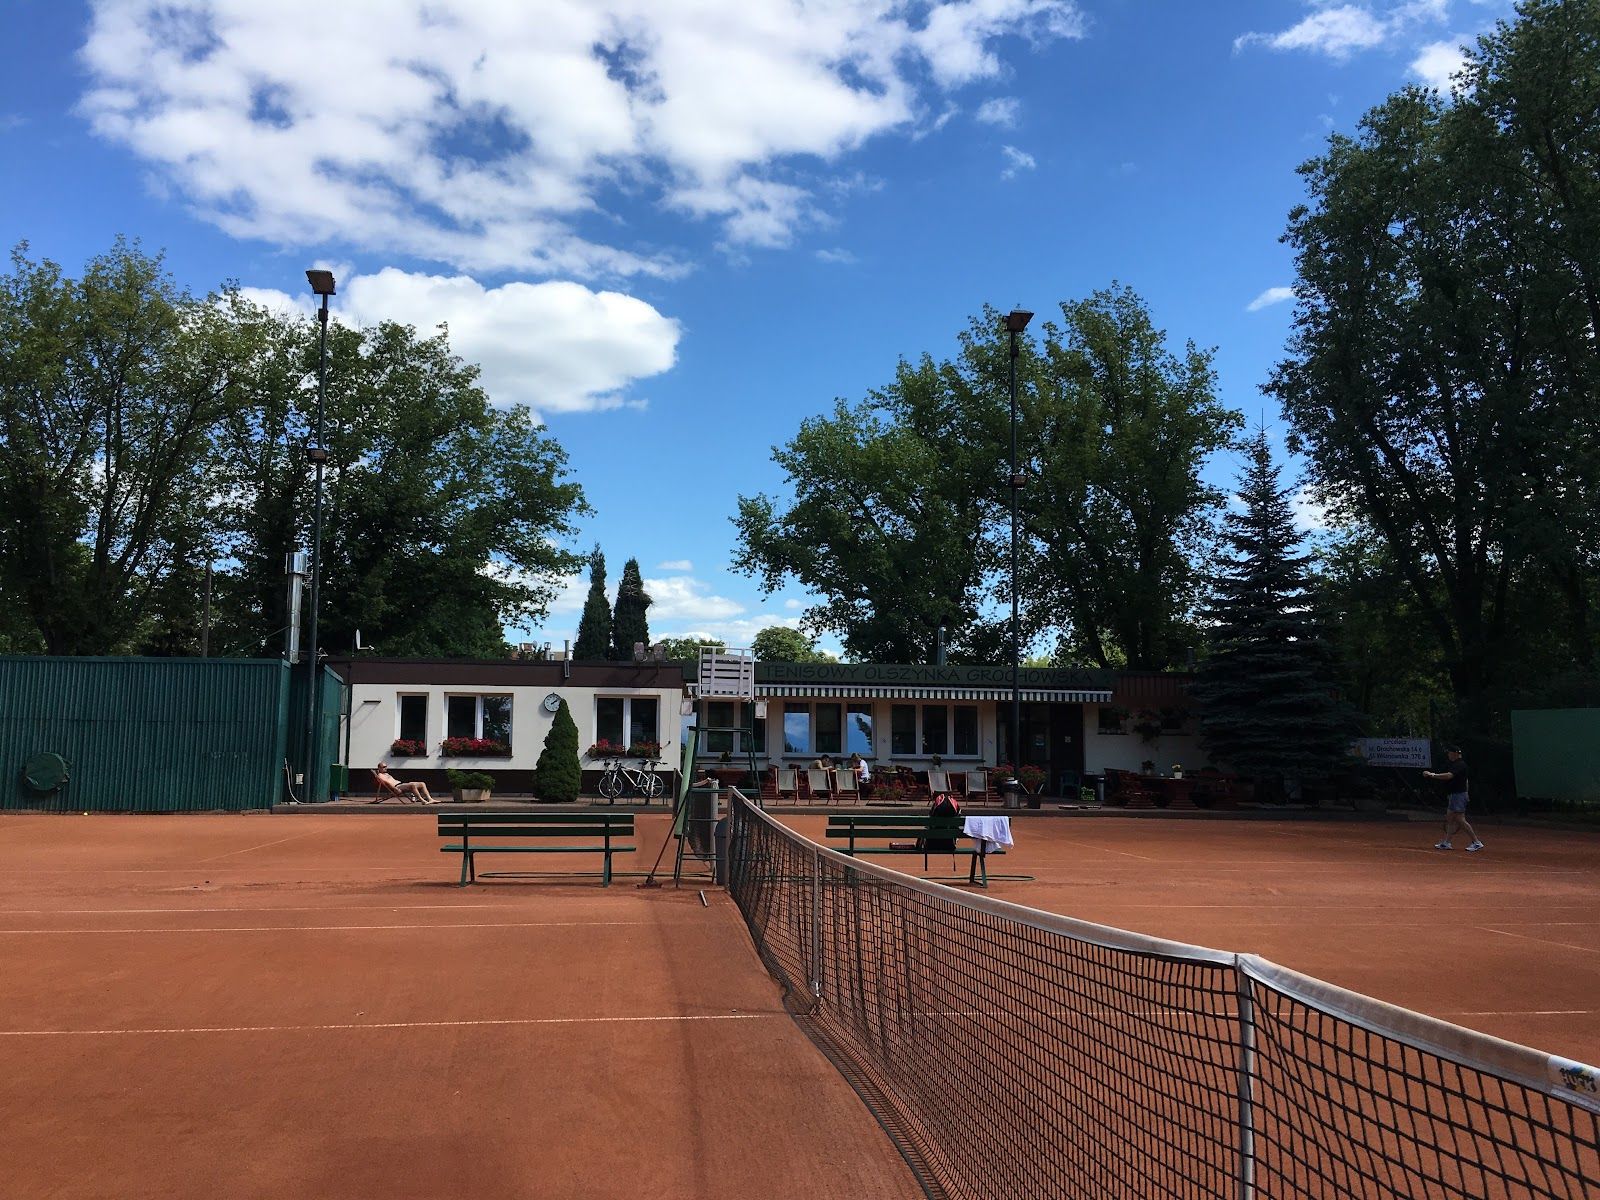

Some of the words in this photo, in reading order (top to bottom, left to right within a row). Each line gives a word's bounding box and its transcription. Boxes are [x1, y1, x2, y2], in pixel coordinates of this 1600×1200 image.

[763, 664, 860, 679] TENISOWY
[864, 666, 960, 681] OLSZYNKA
[966, 668, 1093, 684] GROCHOWSKA
